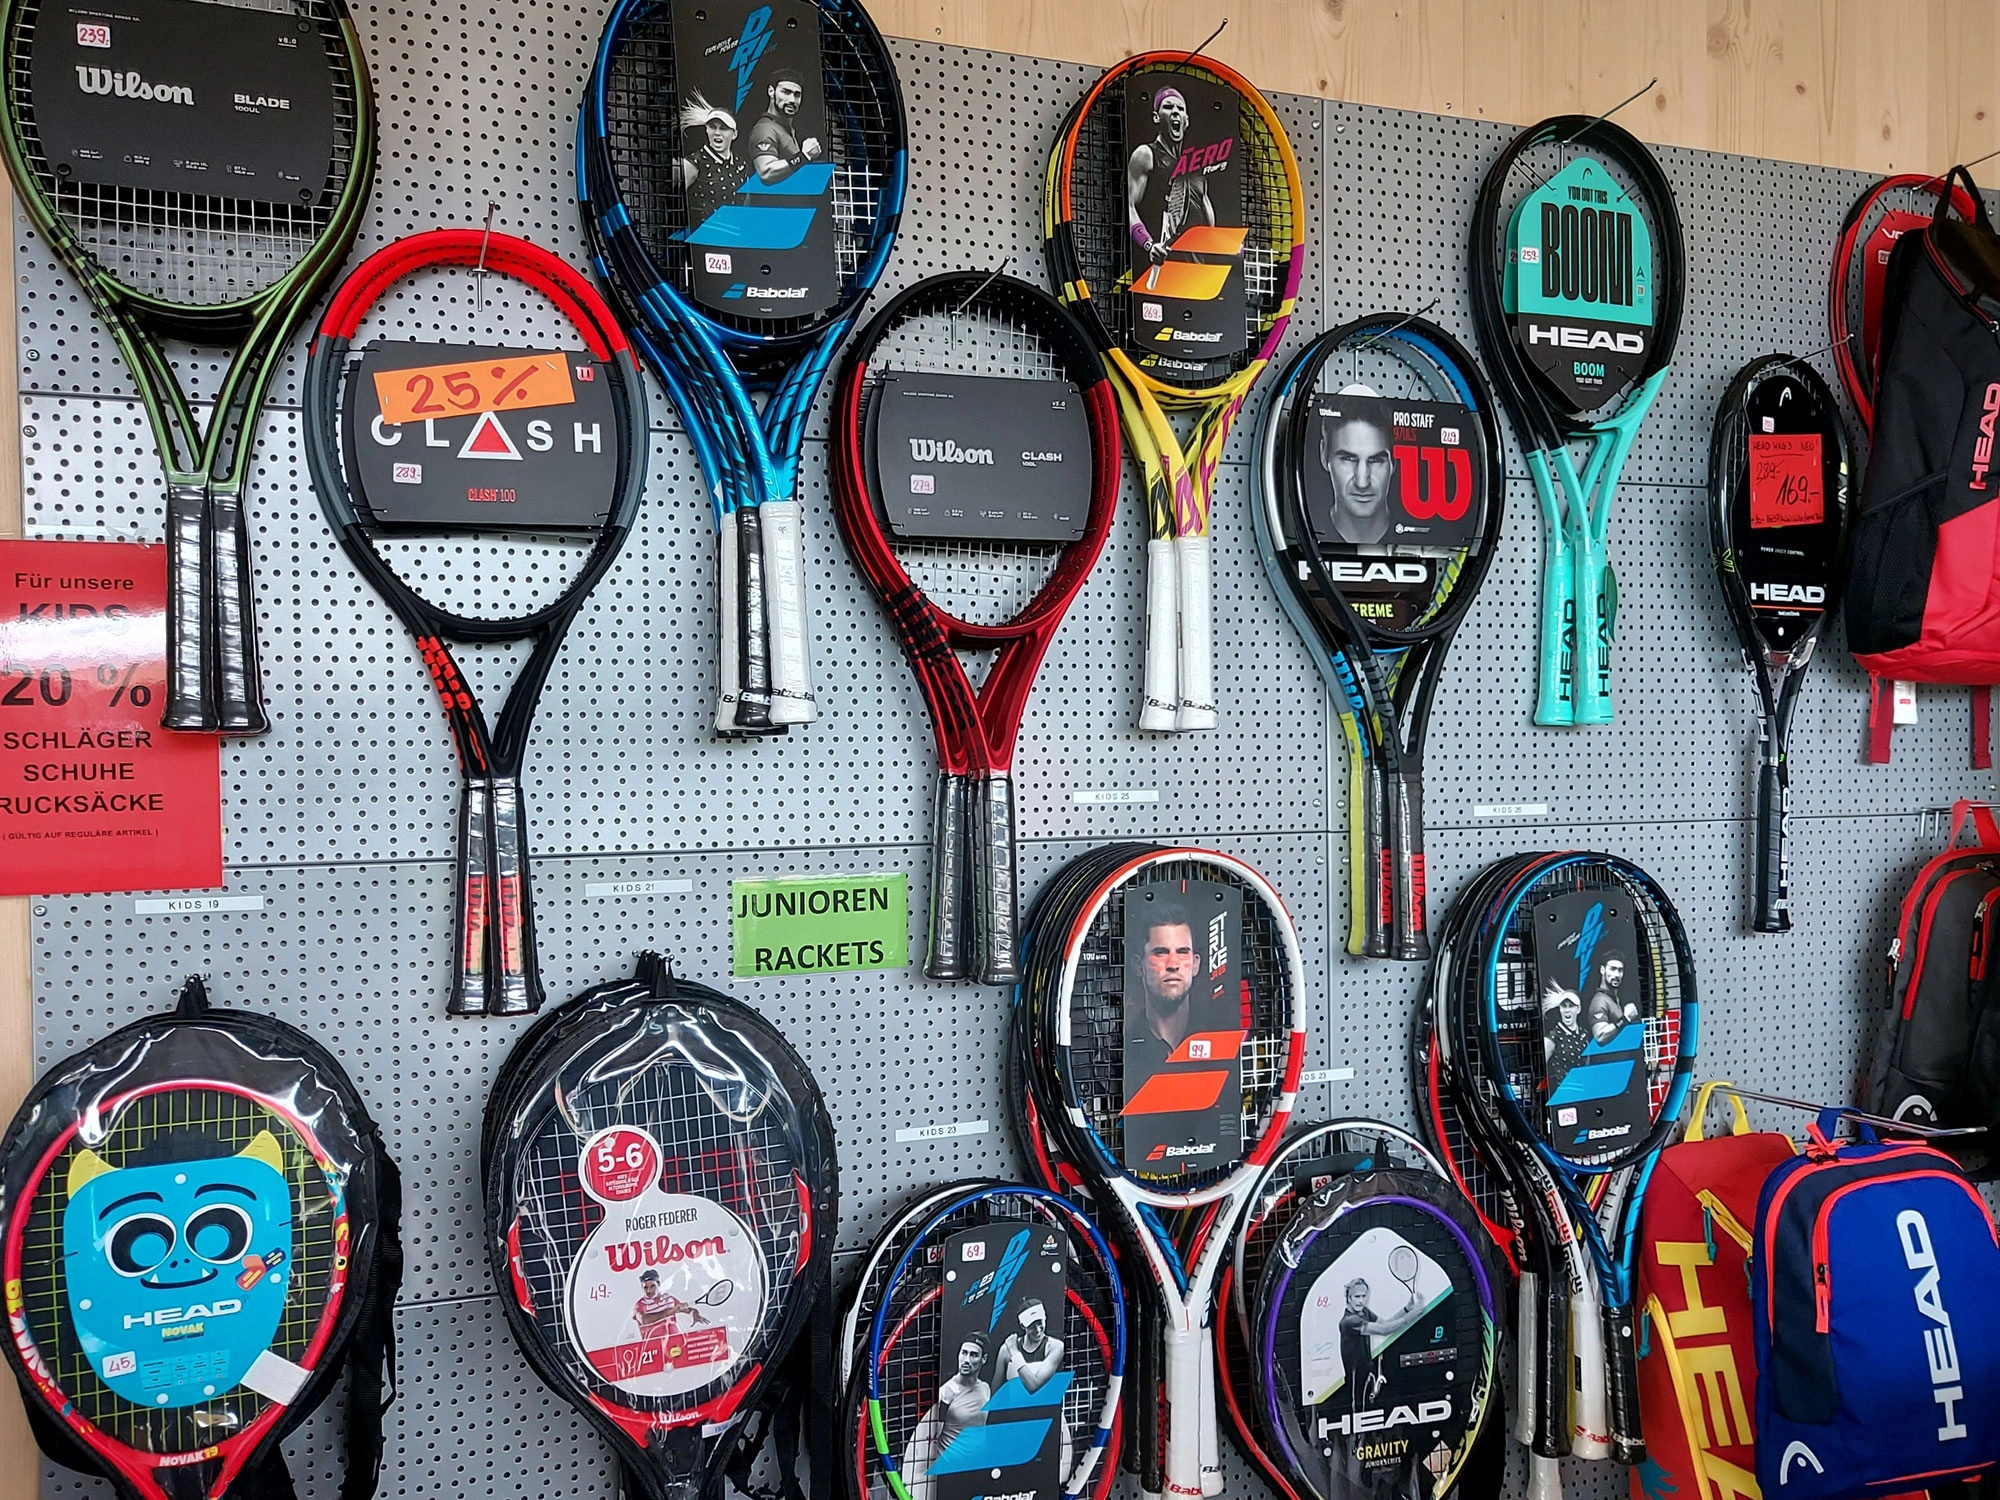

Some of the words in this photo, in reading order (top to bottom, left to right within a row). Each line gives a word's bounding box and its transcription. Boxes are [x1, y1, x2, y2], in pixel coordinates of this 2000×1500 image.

[75, 65, 195, 106] Wilson
[234, 93, 290, 109] BLADE
[1170, 138, 1232, 178] AERO
[1568, 185, 1580, 201] YOU
[1541, 202, 1633, 307] BOOM
[1529, 324, 1644, 354] HEAD
[1573, 361, 1604, 377] BOOM
[1393, 412, 1410, 426] PRO
[1411, 413, 1434, 428] STAFF
[1969, 383, 2000, 490] HEAD
[909, 439, 994, 465] Wilson
[1022, 451, 1062, 462] CLASH
[500, 489, 516, 503] 100
[15, 573, 51, 589] Für
[60, 574, 134, 591] unsere
[1750, 582, 1825, 603] HEAD
[1350, 602, 1394, 618] TREME
[1560, 599, 1575, 701] HEAD
[3, 663, 71, 707] 20
[97, 663, 151, 708] %
[4, 728, 153, 749] SCHLÄGER
[24, 762, 134, 781] SCHUHE
[0, 790, 164, 815] RUCKSÄCKE
[1095, 793, 1118, 801] KIDS
[7, 830, 42, 841] GÜLTIG
[44, 830, 62, 840] AUF
[64, 828, 114, 839] REGULÄRE
[116, 827, 153, 838] ARTIKEL
[613, 884, 642, 893] KIDS
[645, 883, 655, 892] 21
[168, 900, 203, 911] KIDS
[207, 899, 220, 909] 19
[737, 887, 889, 919] JUNIOREN
[755, 940, 884, 973] RACKETS
[1301, 1073, 1316, 1081] IDS
[919, 1128, 944, 1136] KIDS
[947, 1126, 957, 1134] 23
[598, 1143, 644, 1173] 5-6
[625, 1213, 657, 1233] ROGER
[658, 1207, 698, 1227] FEDERER
[605, 1235, 727, 1273] Wilson
[123, 1299, 242, 1330] HEAD
[161, 1322, 204, 1338] NOVAK
[1896, 1209, 1968, 1442] HEAD
[1655, 1241, 1761, 1500] HEA
[660, 1409, 701, 1424] Wilson
[1319, 1400, 1451, 1439] HEAD
[159, 1449, 205, 1467] NOVAK
[205, 1446, 219, 1461] 19
[1356, 1439, 1409, 1461] GRAVITY
